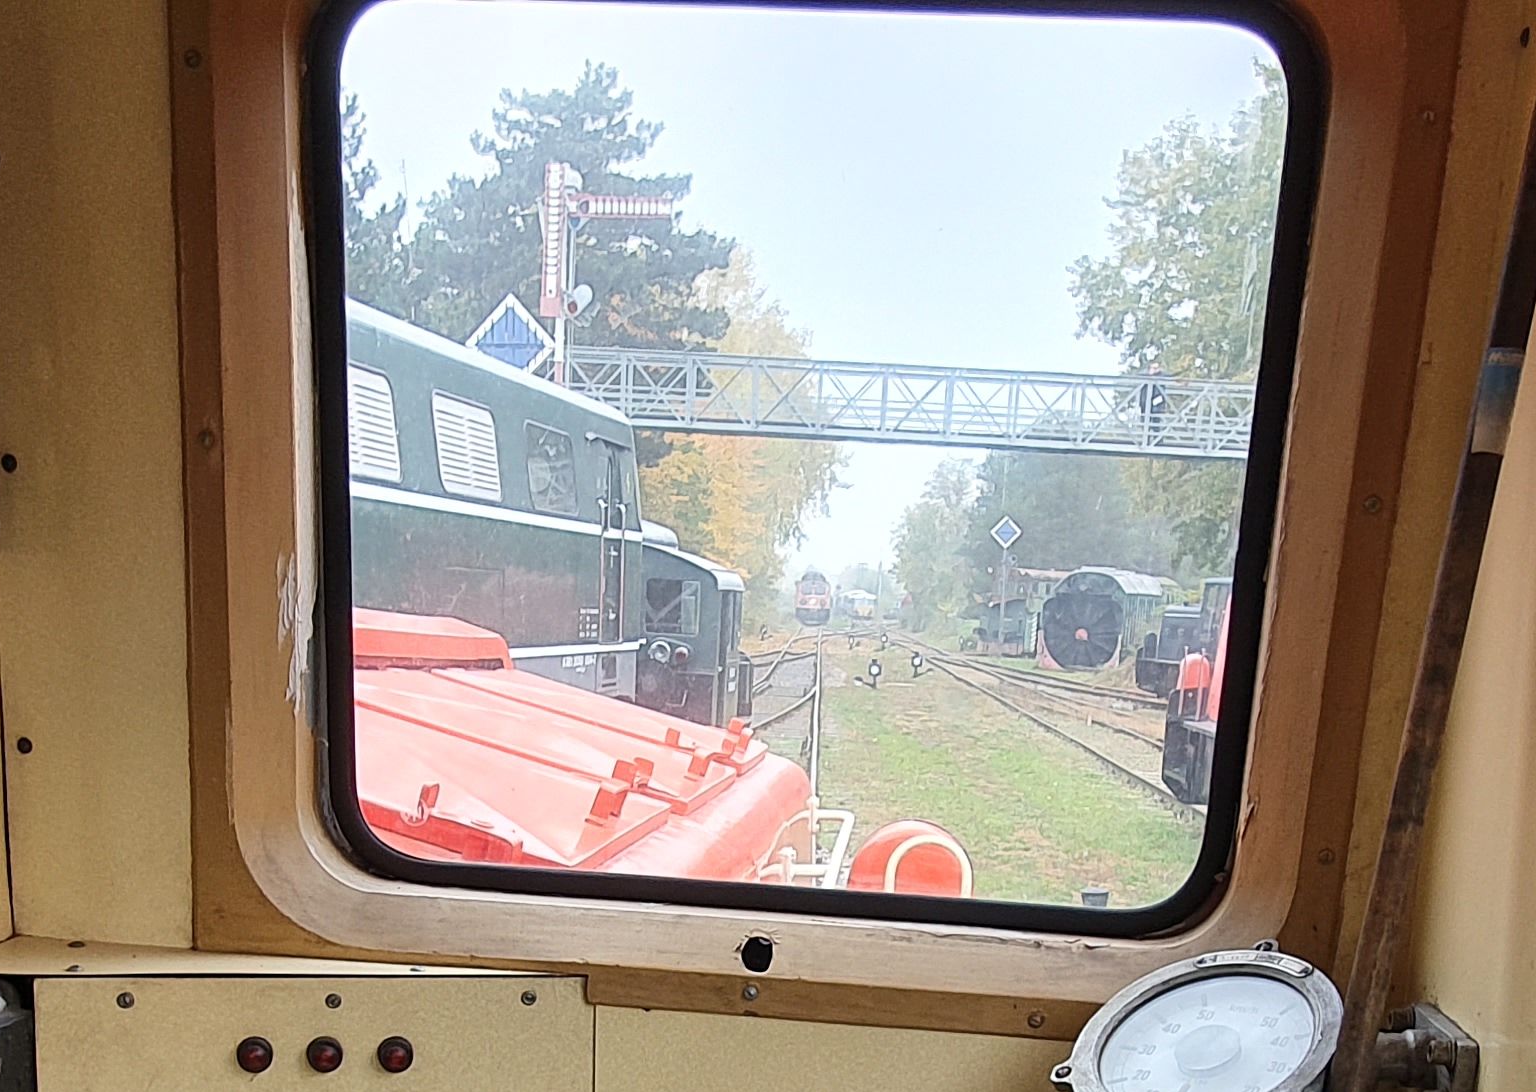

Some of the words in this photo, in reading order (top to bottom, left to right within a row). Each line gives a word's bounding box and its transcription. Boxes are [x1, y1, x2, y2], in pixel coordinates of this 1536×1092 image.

[1196, 1010, 1214, 1021] 50
[1163, 1023, 1181, 1034] 40
[1260, 1017, 1279, 1029] 50
[1270, 1036, 1289, 1048] 40
[1137, 1044, 1156, 1056] 30
[1267, 1061, 1286, 1073] 30
[1132, 1069, 1151, 1081] 20
